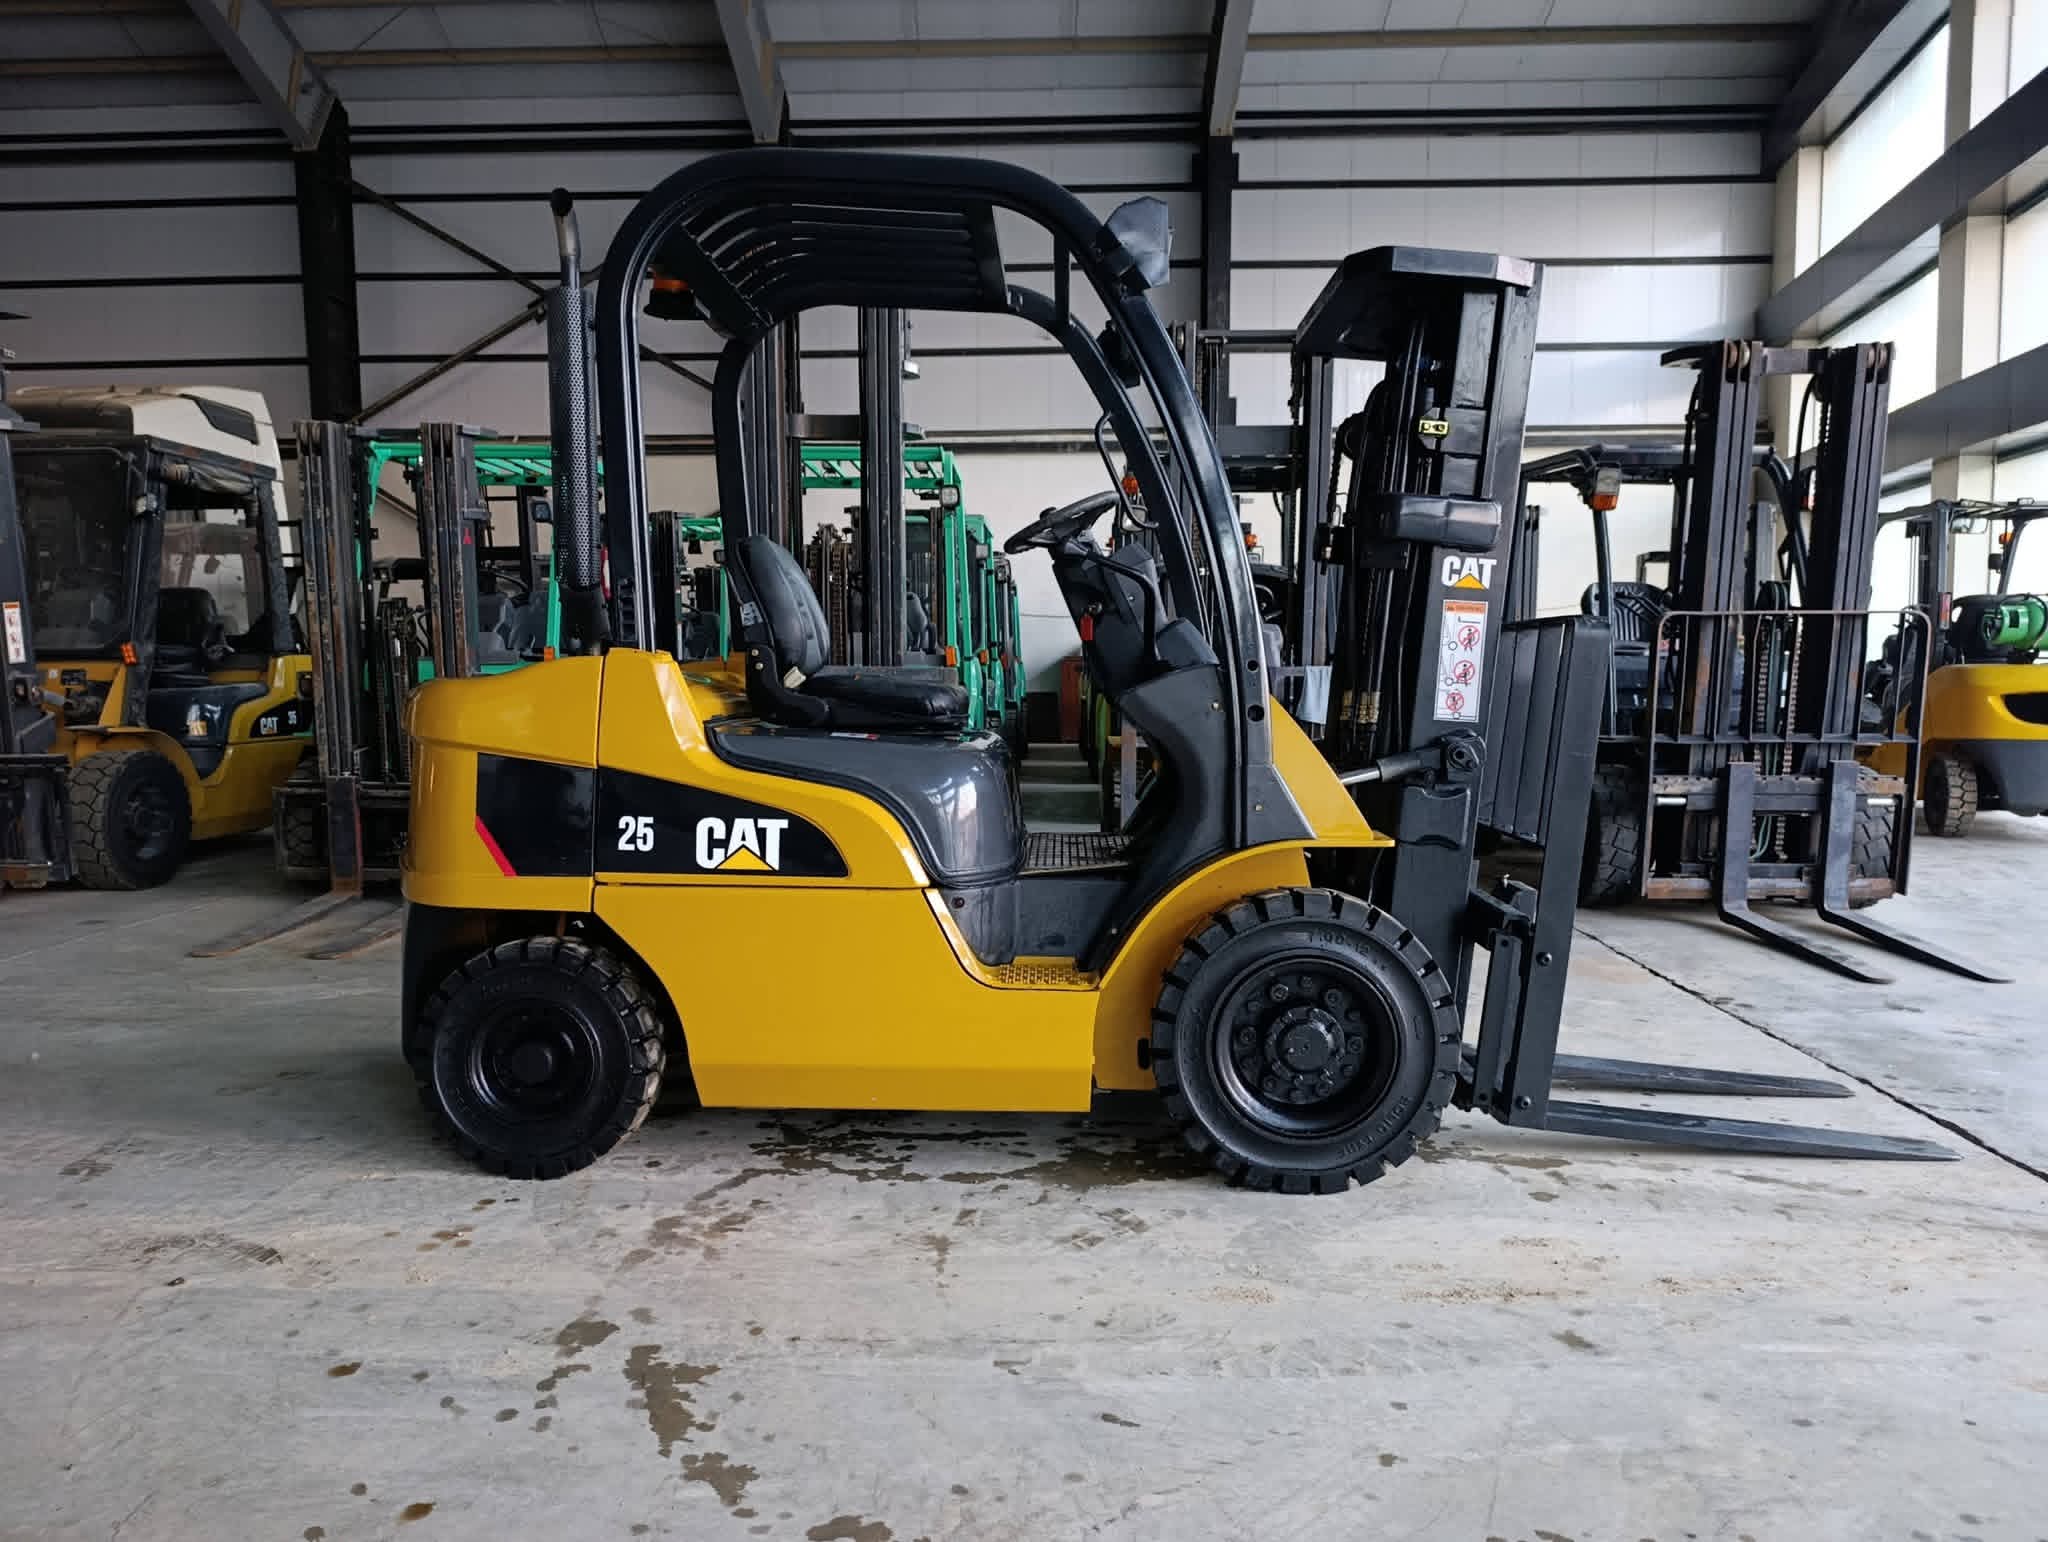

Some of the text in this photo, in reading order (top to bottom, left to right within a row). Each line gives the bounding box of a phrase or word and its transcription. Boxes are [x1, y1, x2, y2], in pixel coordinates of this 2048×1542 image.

[1441, 555, 1497, 590] CAT
[260, 717, 279, 735] CAT
[617, 815, 789, 871] 25 CAT
